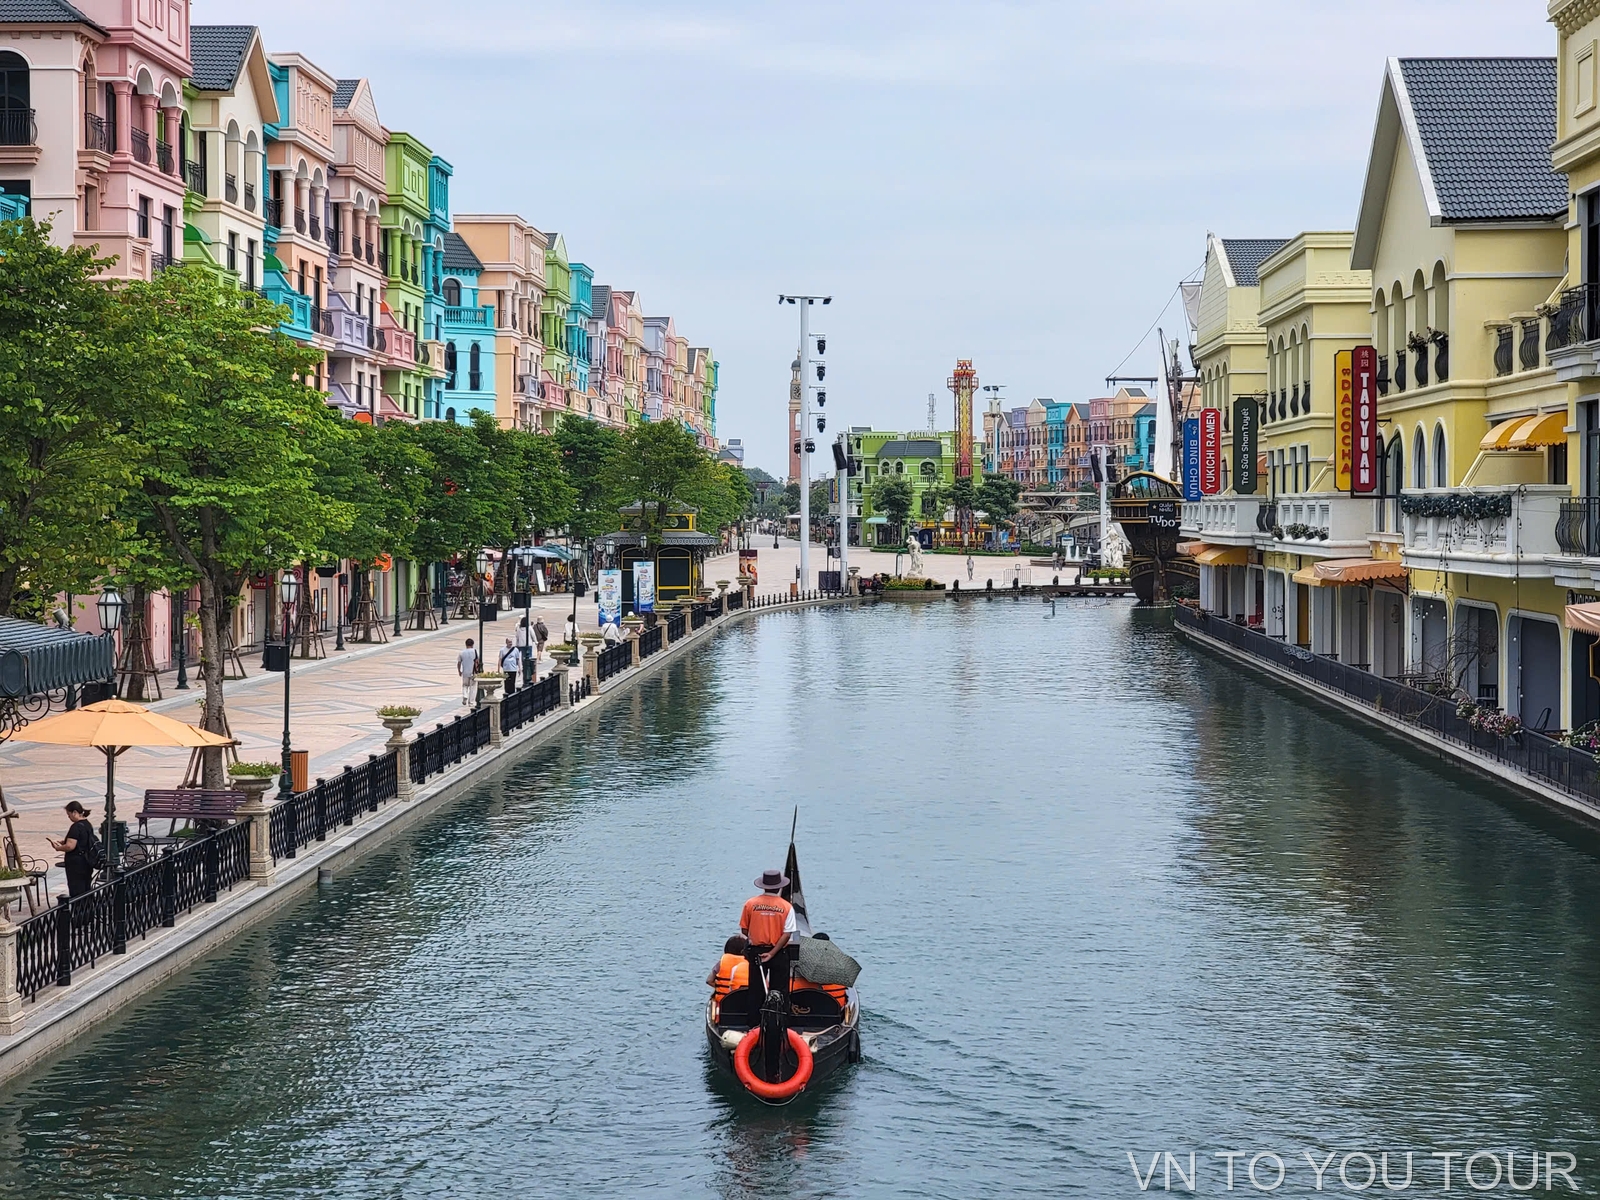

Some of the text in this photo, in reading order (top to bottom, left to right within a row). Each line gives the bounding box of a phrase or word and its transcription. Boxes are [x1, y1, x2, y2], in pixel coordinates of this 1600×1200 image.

[1206, 412, 1216, 490] YUKICHI RAMEN
[1341, 379, 1351, 474] DACOCHA
[1360, 372, 1370, 484] TAOYUAN
[1189, 439, 1198, 498] BING CHUN
[1241, 471, 1249, 486] Trà
